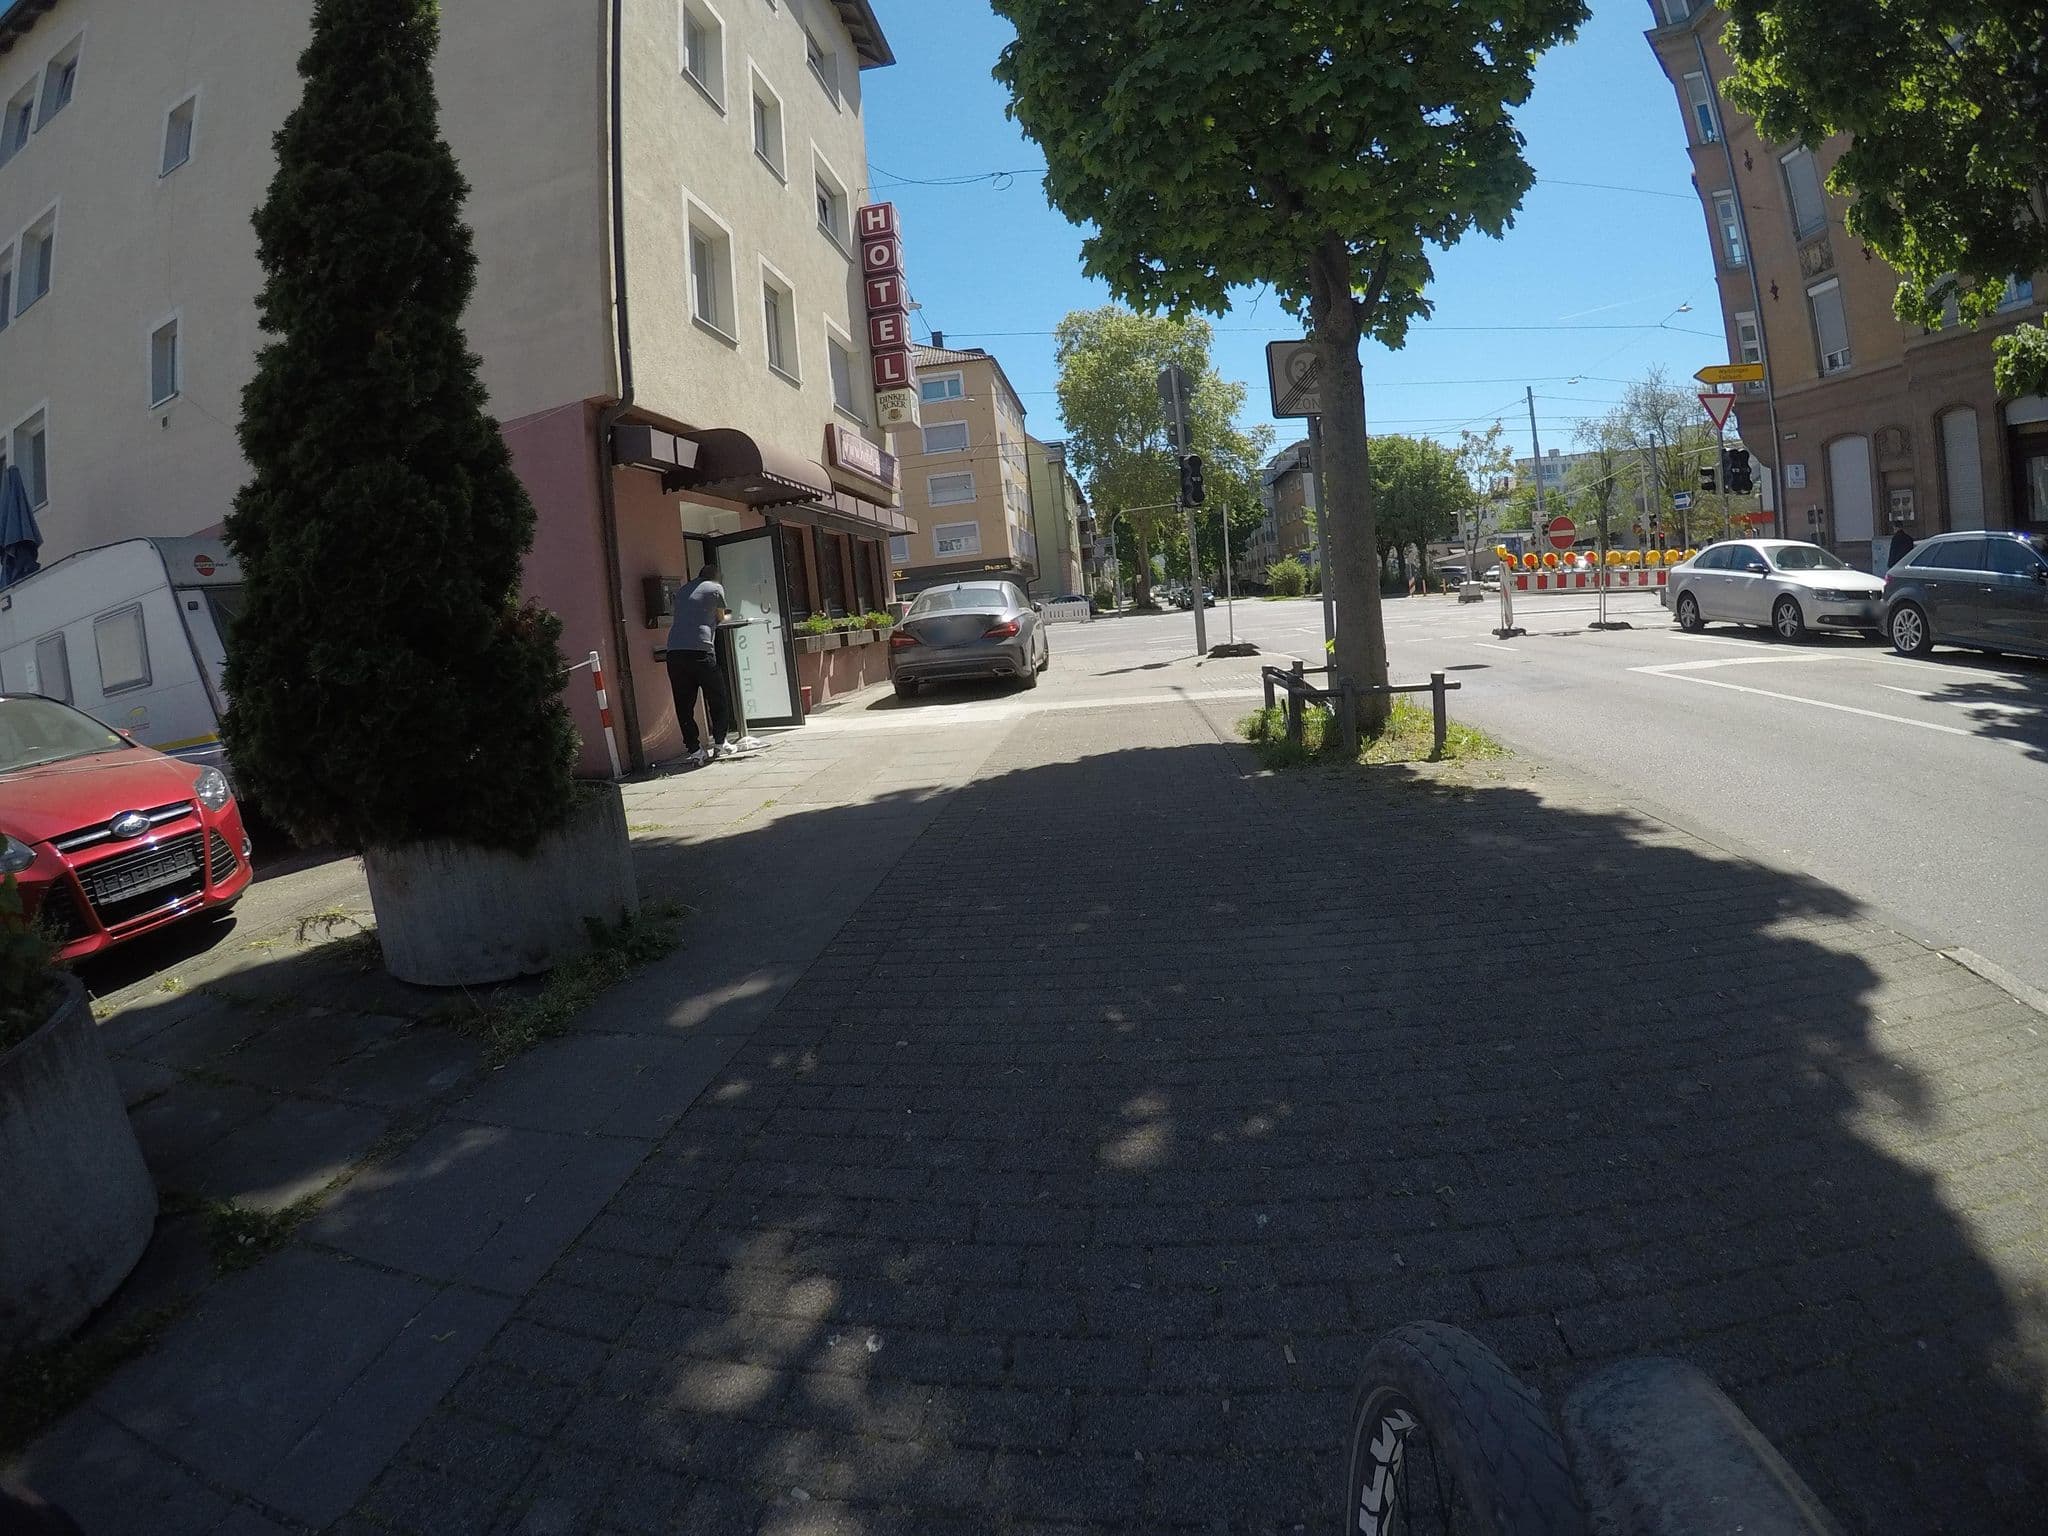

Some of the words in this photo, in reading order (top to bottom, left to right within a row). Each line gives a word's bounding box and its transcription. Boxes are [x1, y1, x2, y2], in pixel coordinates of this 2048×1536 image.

[867, 208, 899, 380] HOTEL
[880, 393, 906, 404] DINKEL
[1295, 398, 1320, 410] ZON
[882, 401, 907, 411] ACKER
